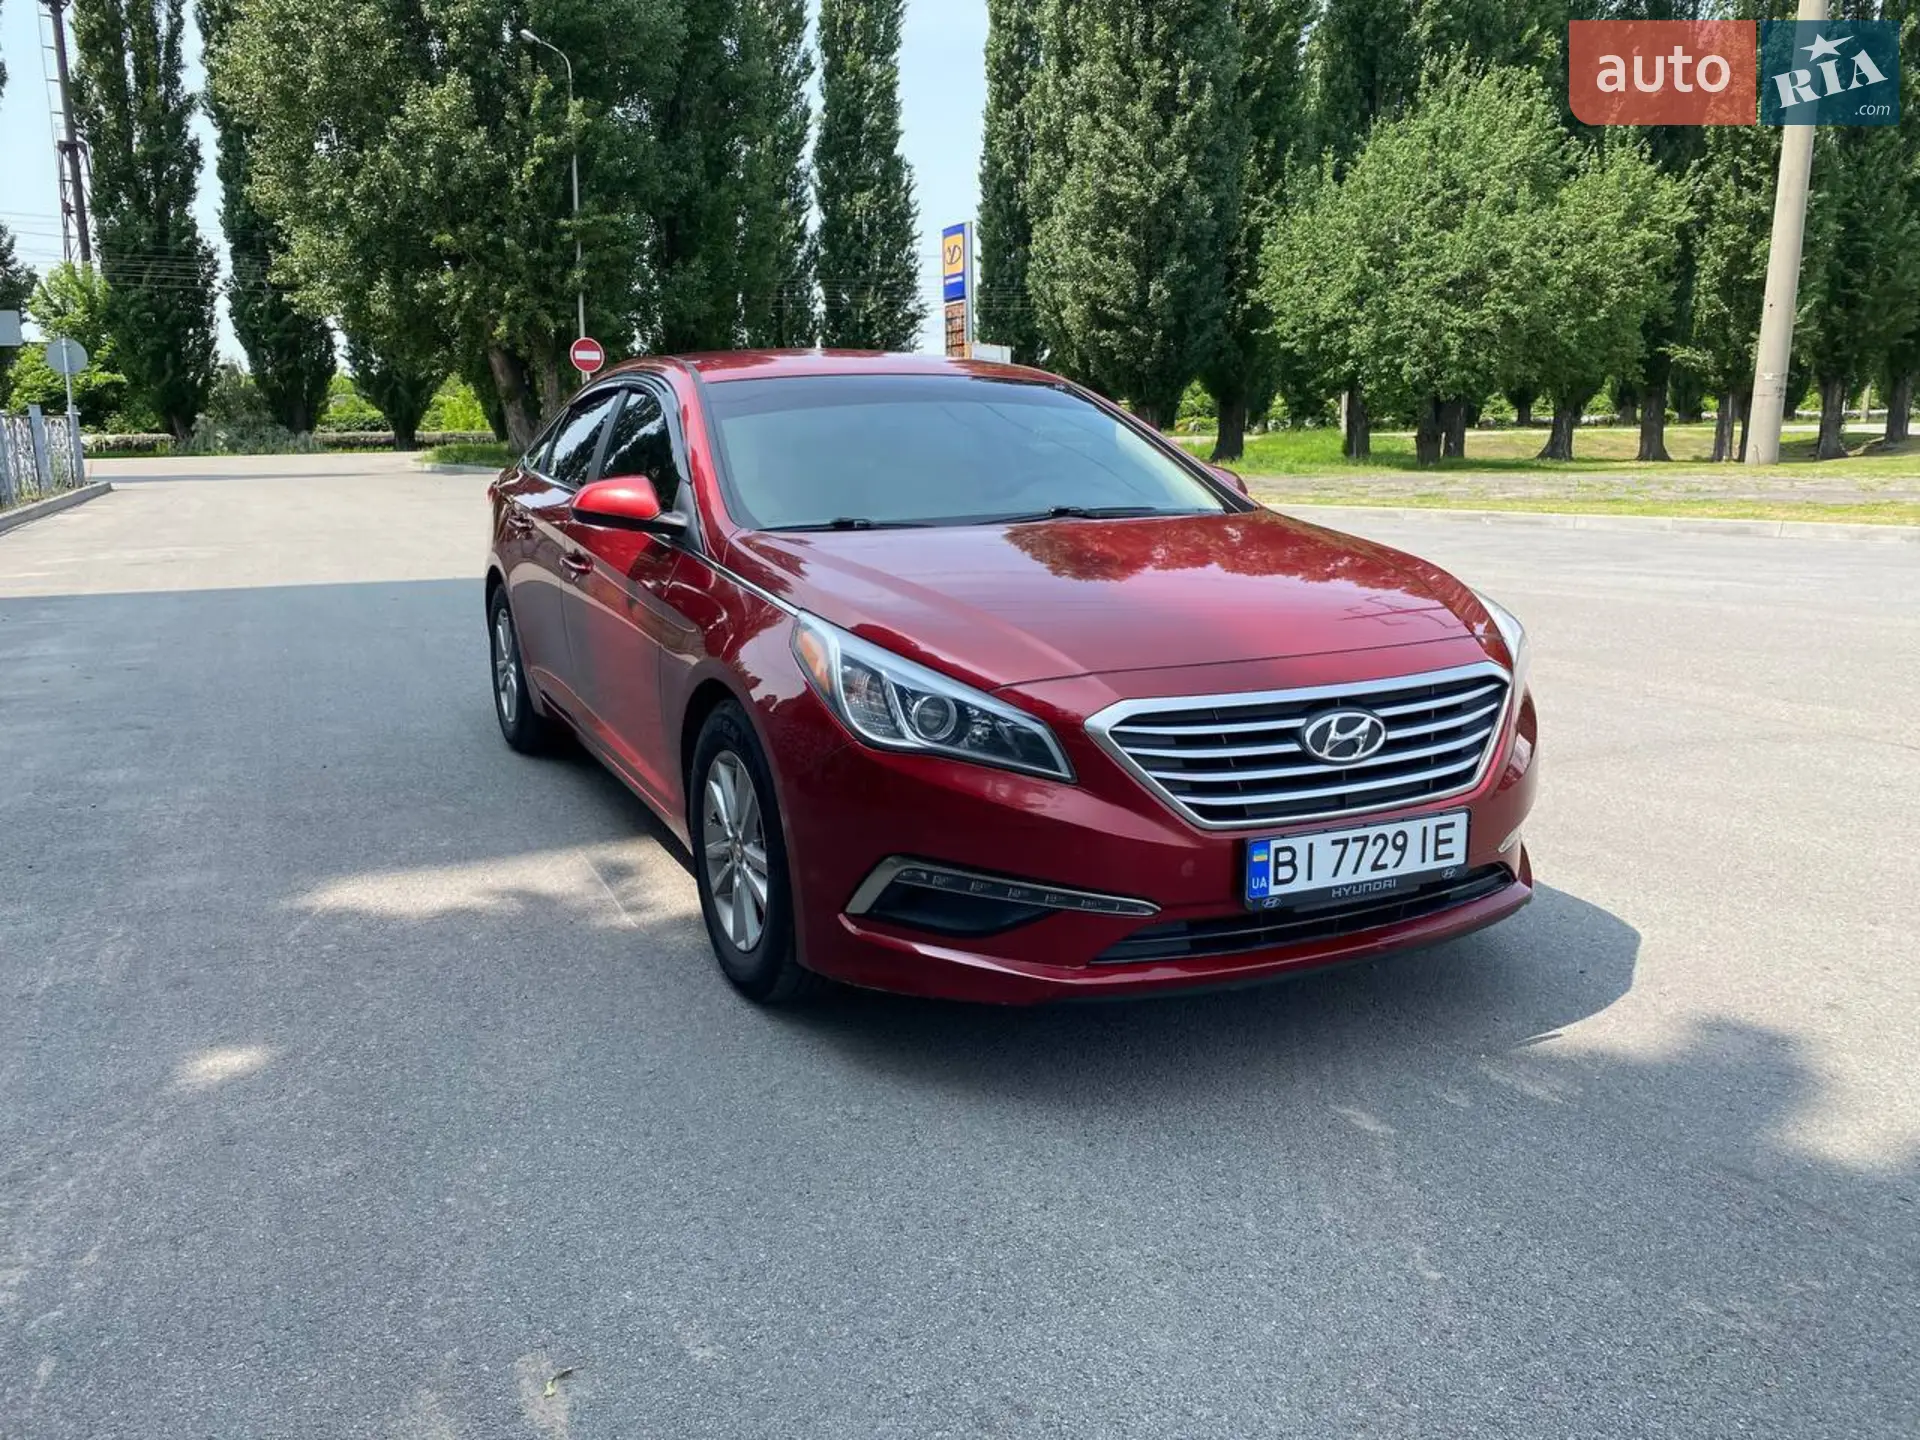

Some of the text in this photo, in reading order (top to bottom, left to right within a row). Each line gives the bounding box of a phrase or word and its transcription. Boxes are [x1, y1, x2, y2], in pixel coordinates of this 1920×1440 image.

[1273, 822, 1455, 886] BI 7729 IE
[1252, 877, 1268, 889] UA
[1332, 879, 1396, 898] HYUNDAI
